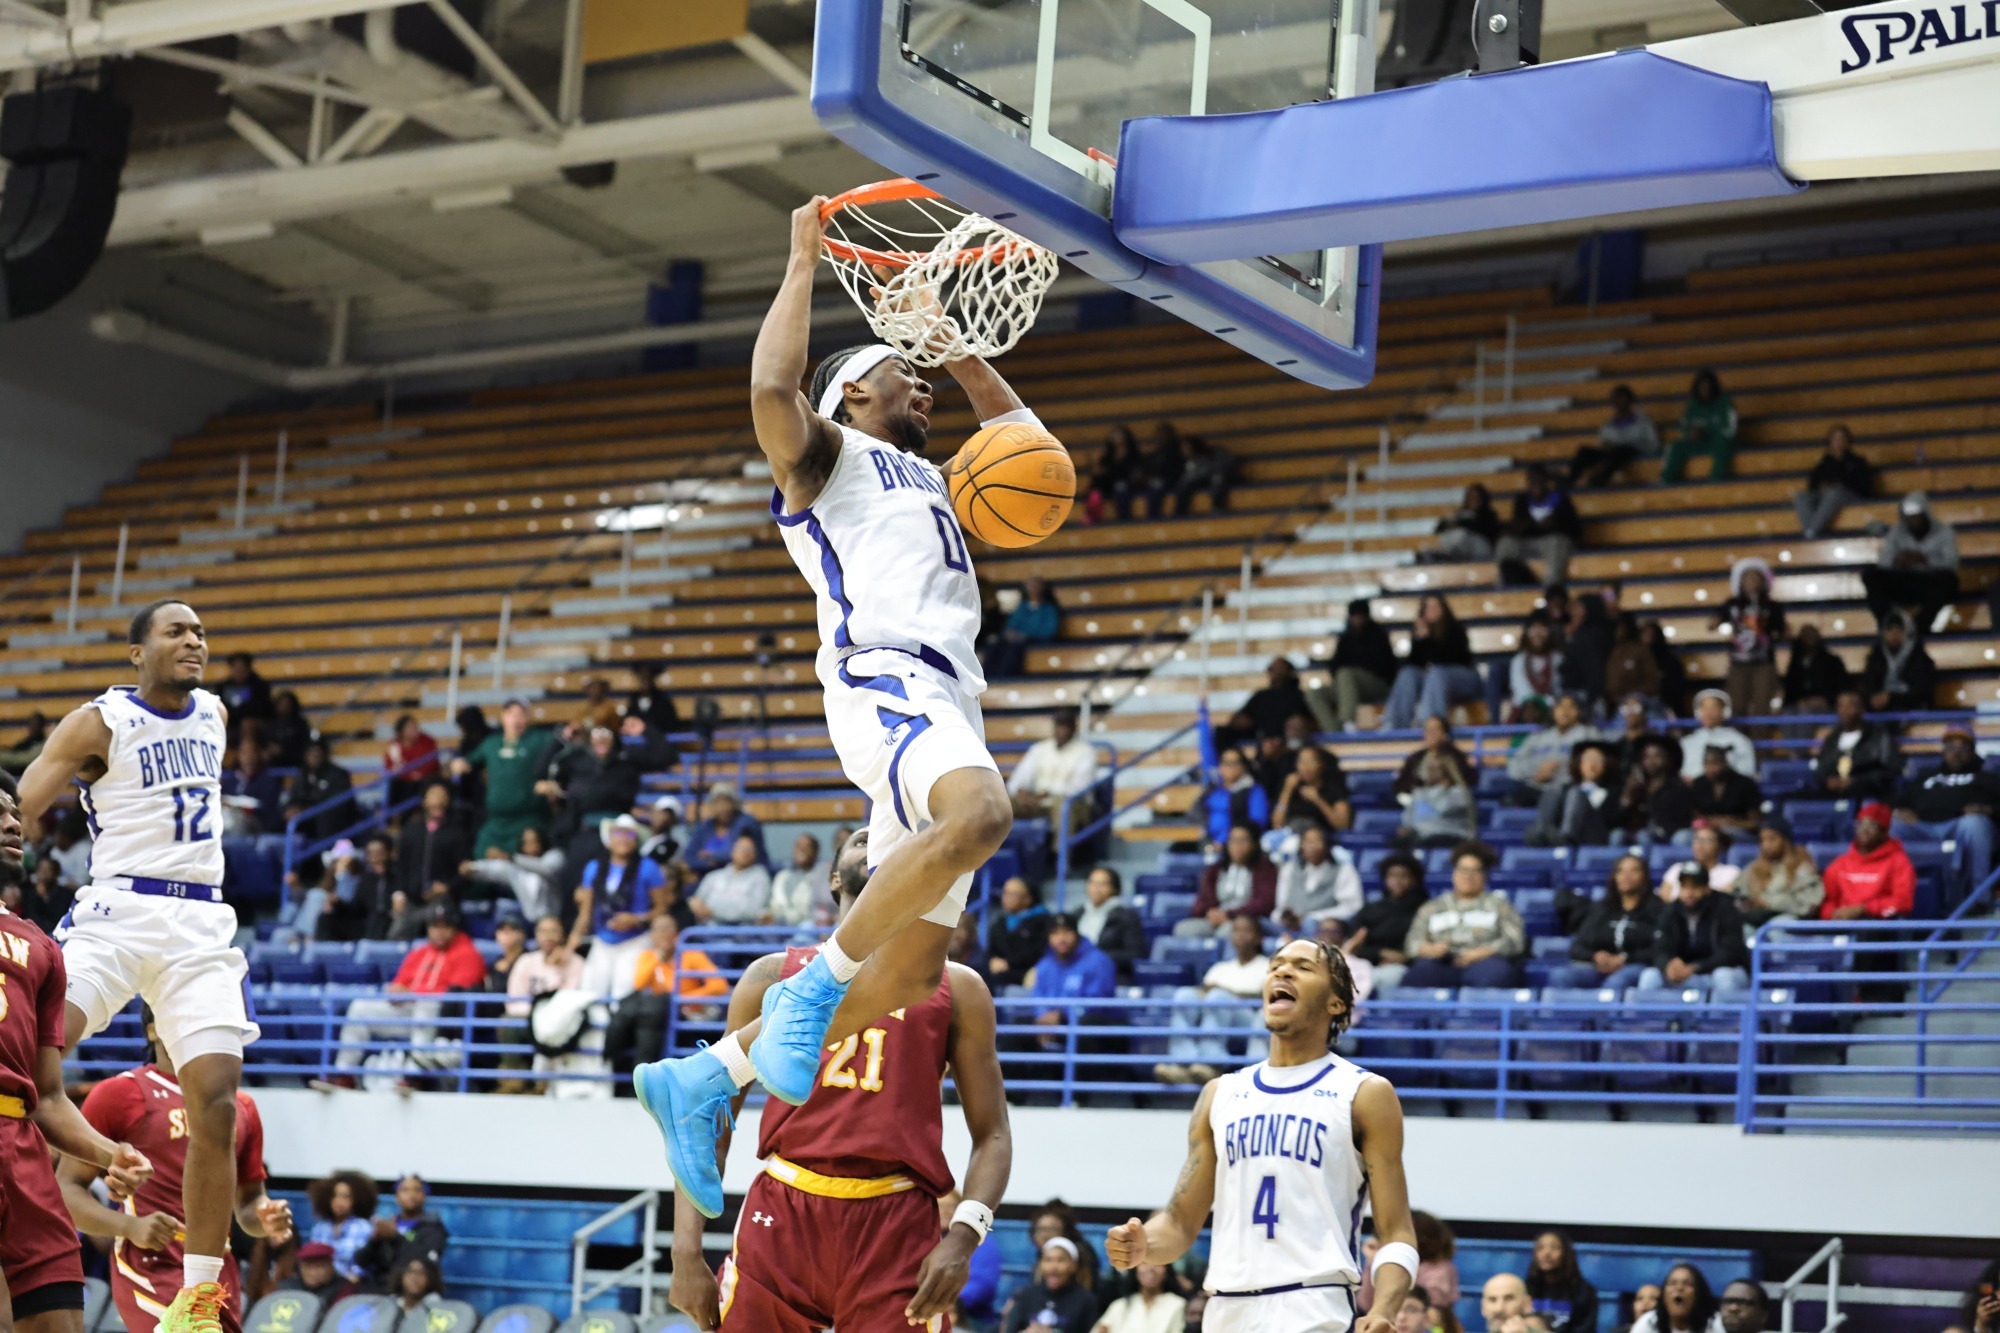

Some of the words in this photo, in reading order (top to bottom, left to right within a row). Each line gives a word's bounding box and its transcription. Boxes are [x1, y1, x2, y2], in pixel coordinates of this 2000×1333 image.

[930, 505, 969, 574] 0
[172, 787, 213, 841] 12
[166, 882, 187, 897] FSU
[822, 1028, 887, 1093] 21
[1225, 1113, 1328, 1168] BRONCOS
[1252, 1175, 1279, 1240] 4
